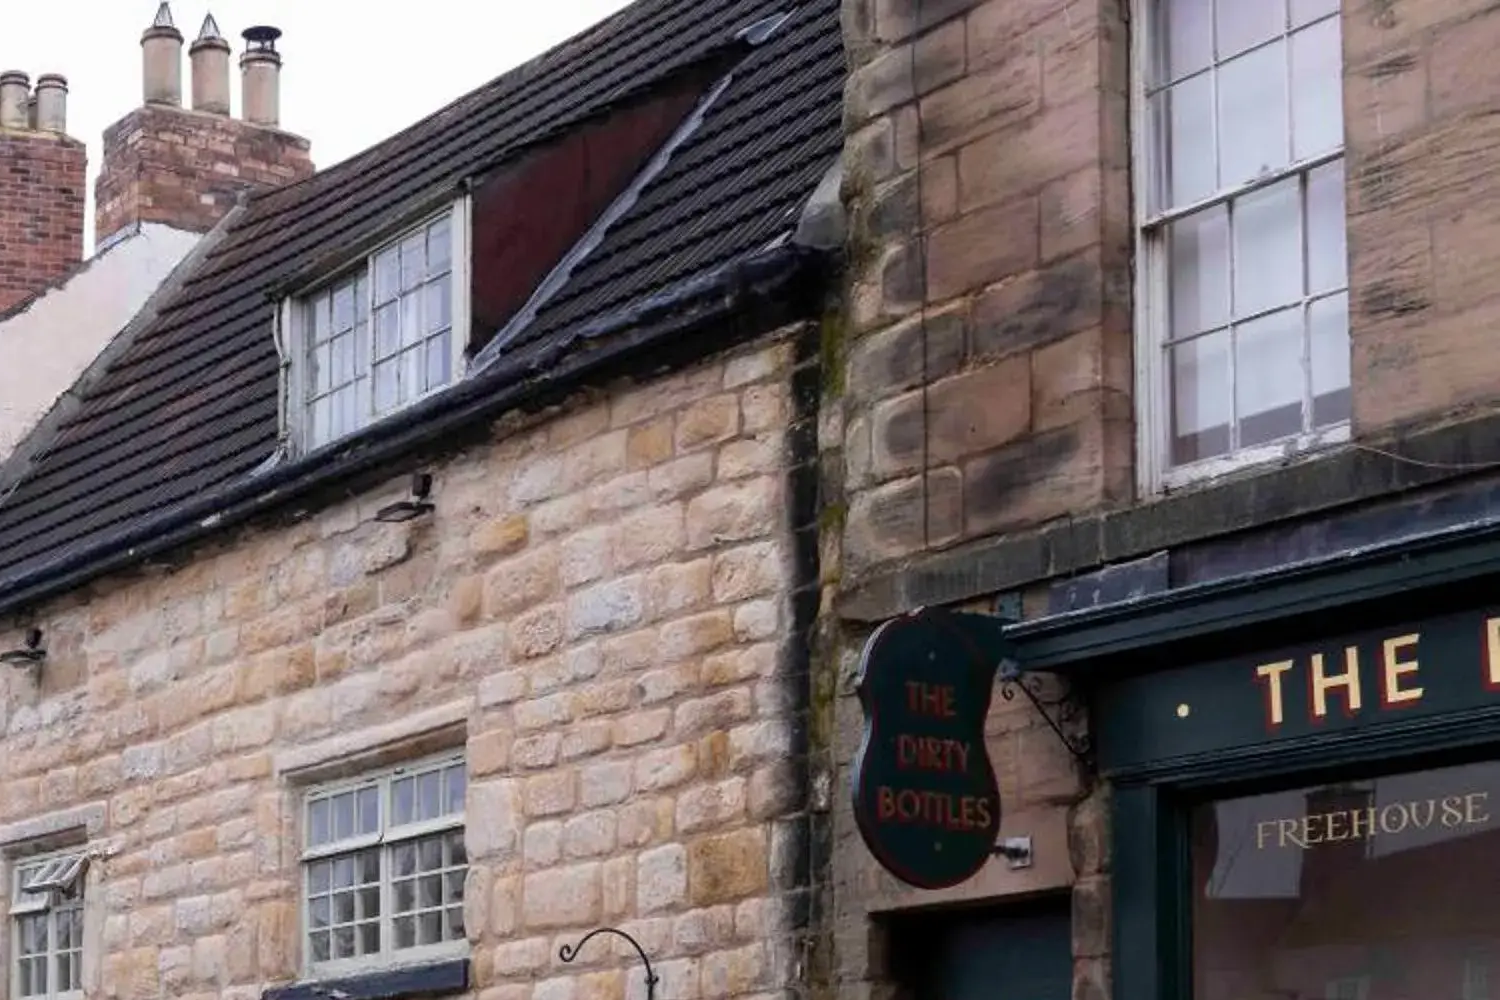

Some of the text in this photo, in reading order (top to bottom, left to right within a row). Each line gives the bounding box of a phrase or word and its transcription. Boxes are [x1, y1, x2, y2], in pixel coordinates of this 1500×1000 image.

[904, 680, 957, 717] THE
[1255, 632, 1425, 724] THE
[895, 734, 971, 773] DIRTY
[876, 786, 992, 831] BOTTLES
[1257, 792, 1490, 849] FREEHOUSE
